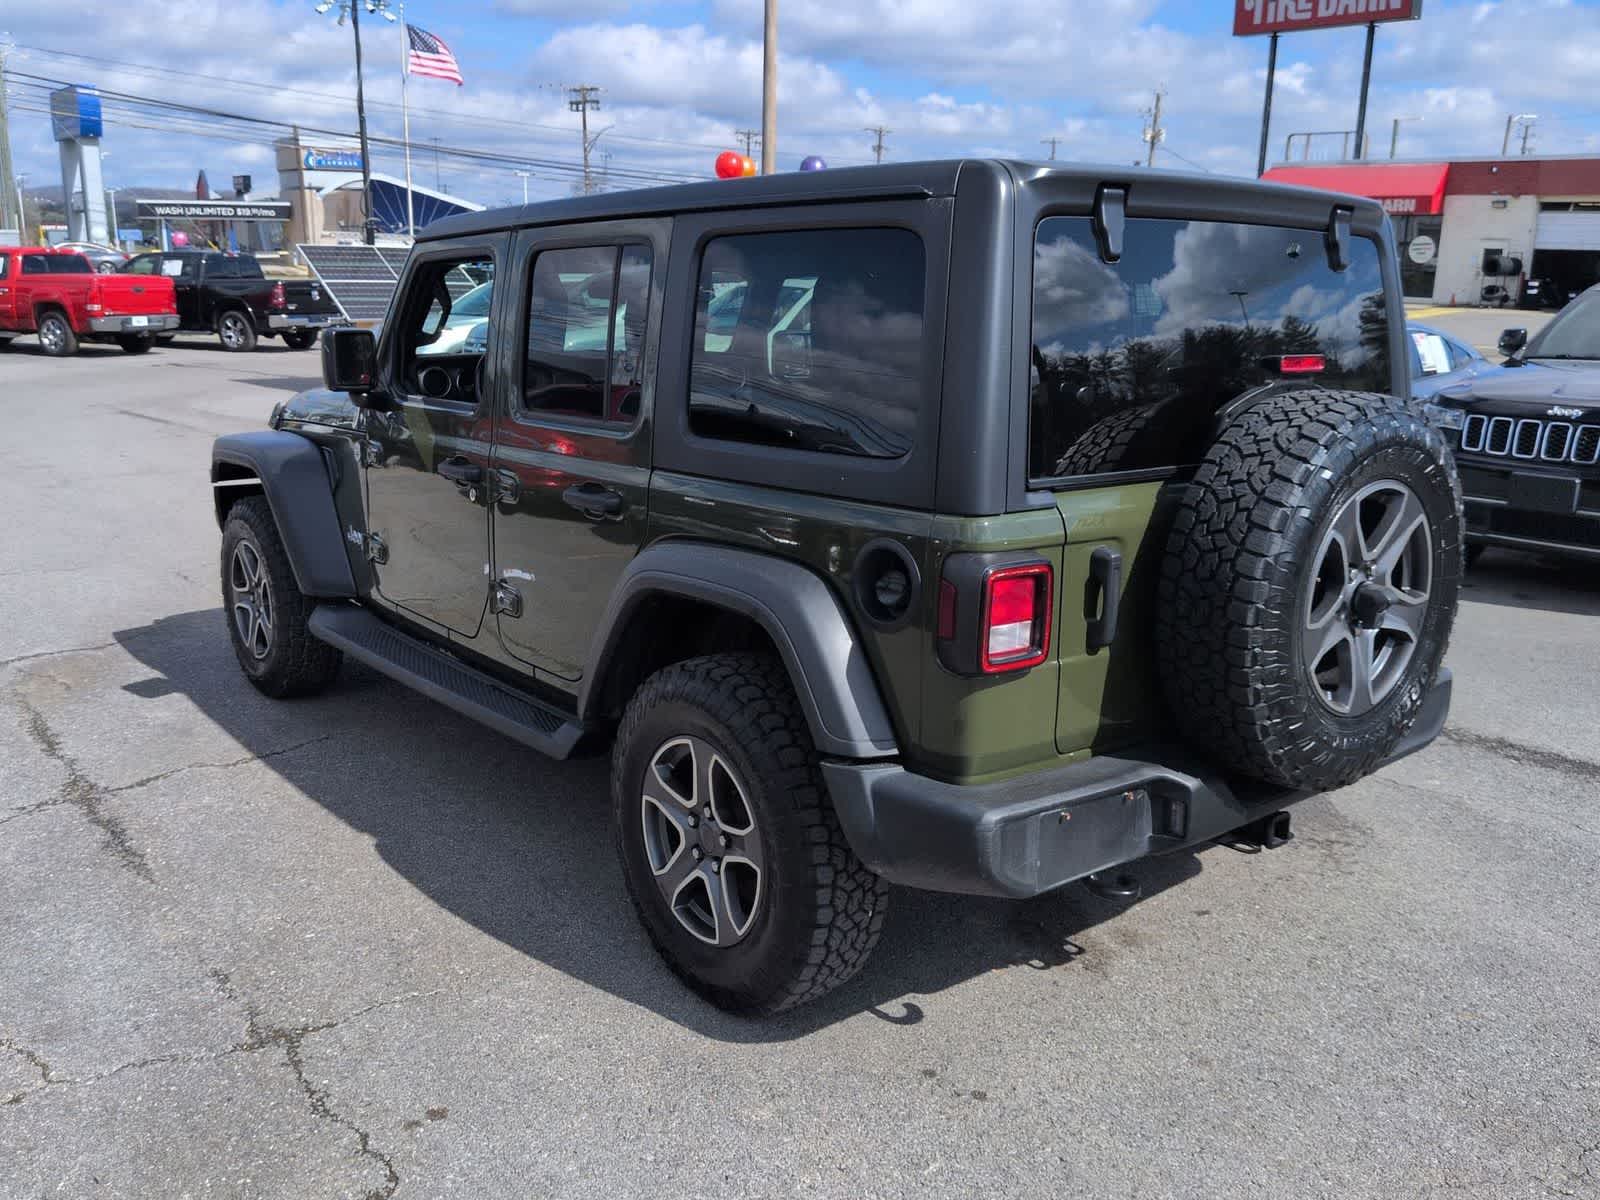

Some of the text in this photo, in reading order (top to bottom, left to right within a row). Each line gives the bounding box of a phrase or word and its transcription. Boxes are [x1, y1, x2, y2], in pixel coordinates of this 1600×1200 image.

[155, 207, 183, 215] WASH
[185, 207, 234, 216] UNLIMITED
[1547, 405, 1583, 419] Jeep
